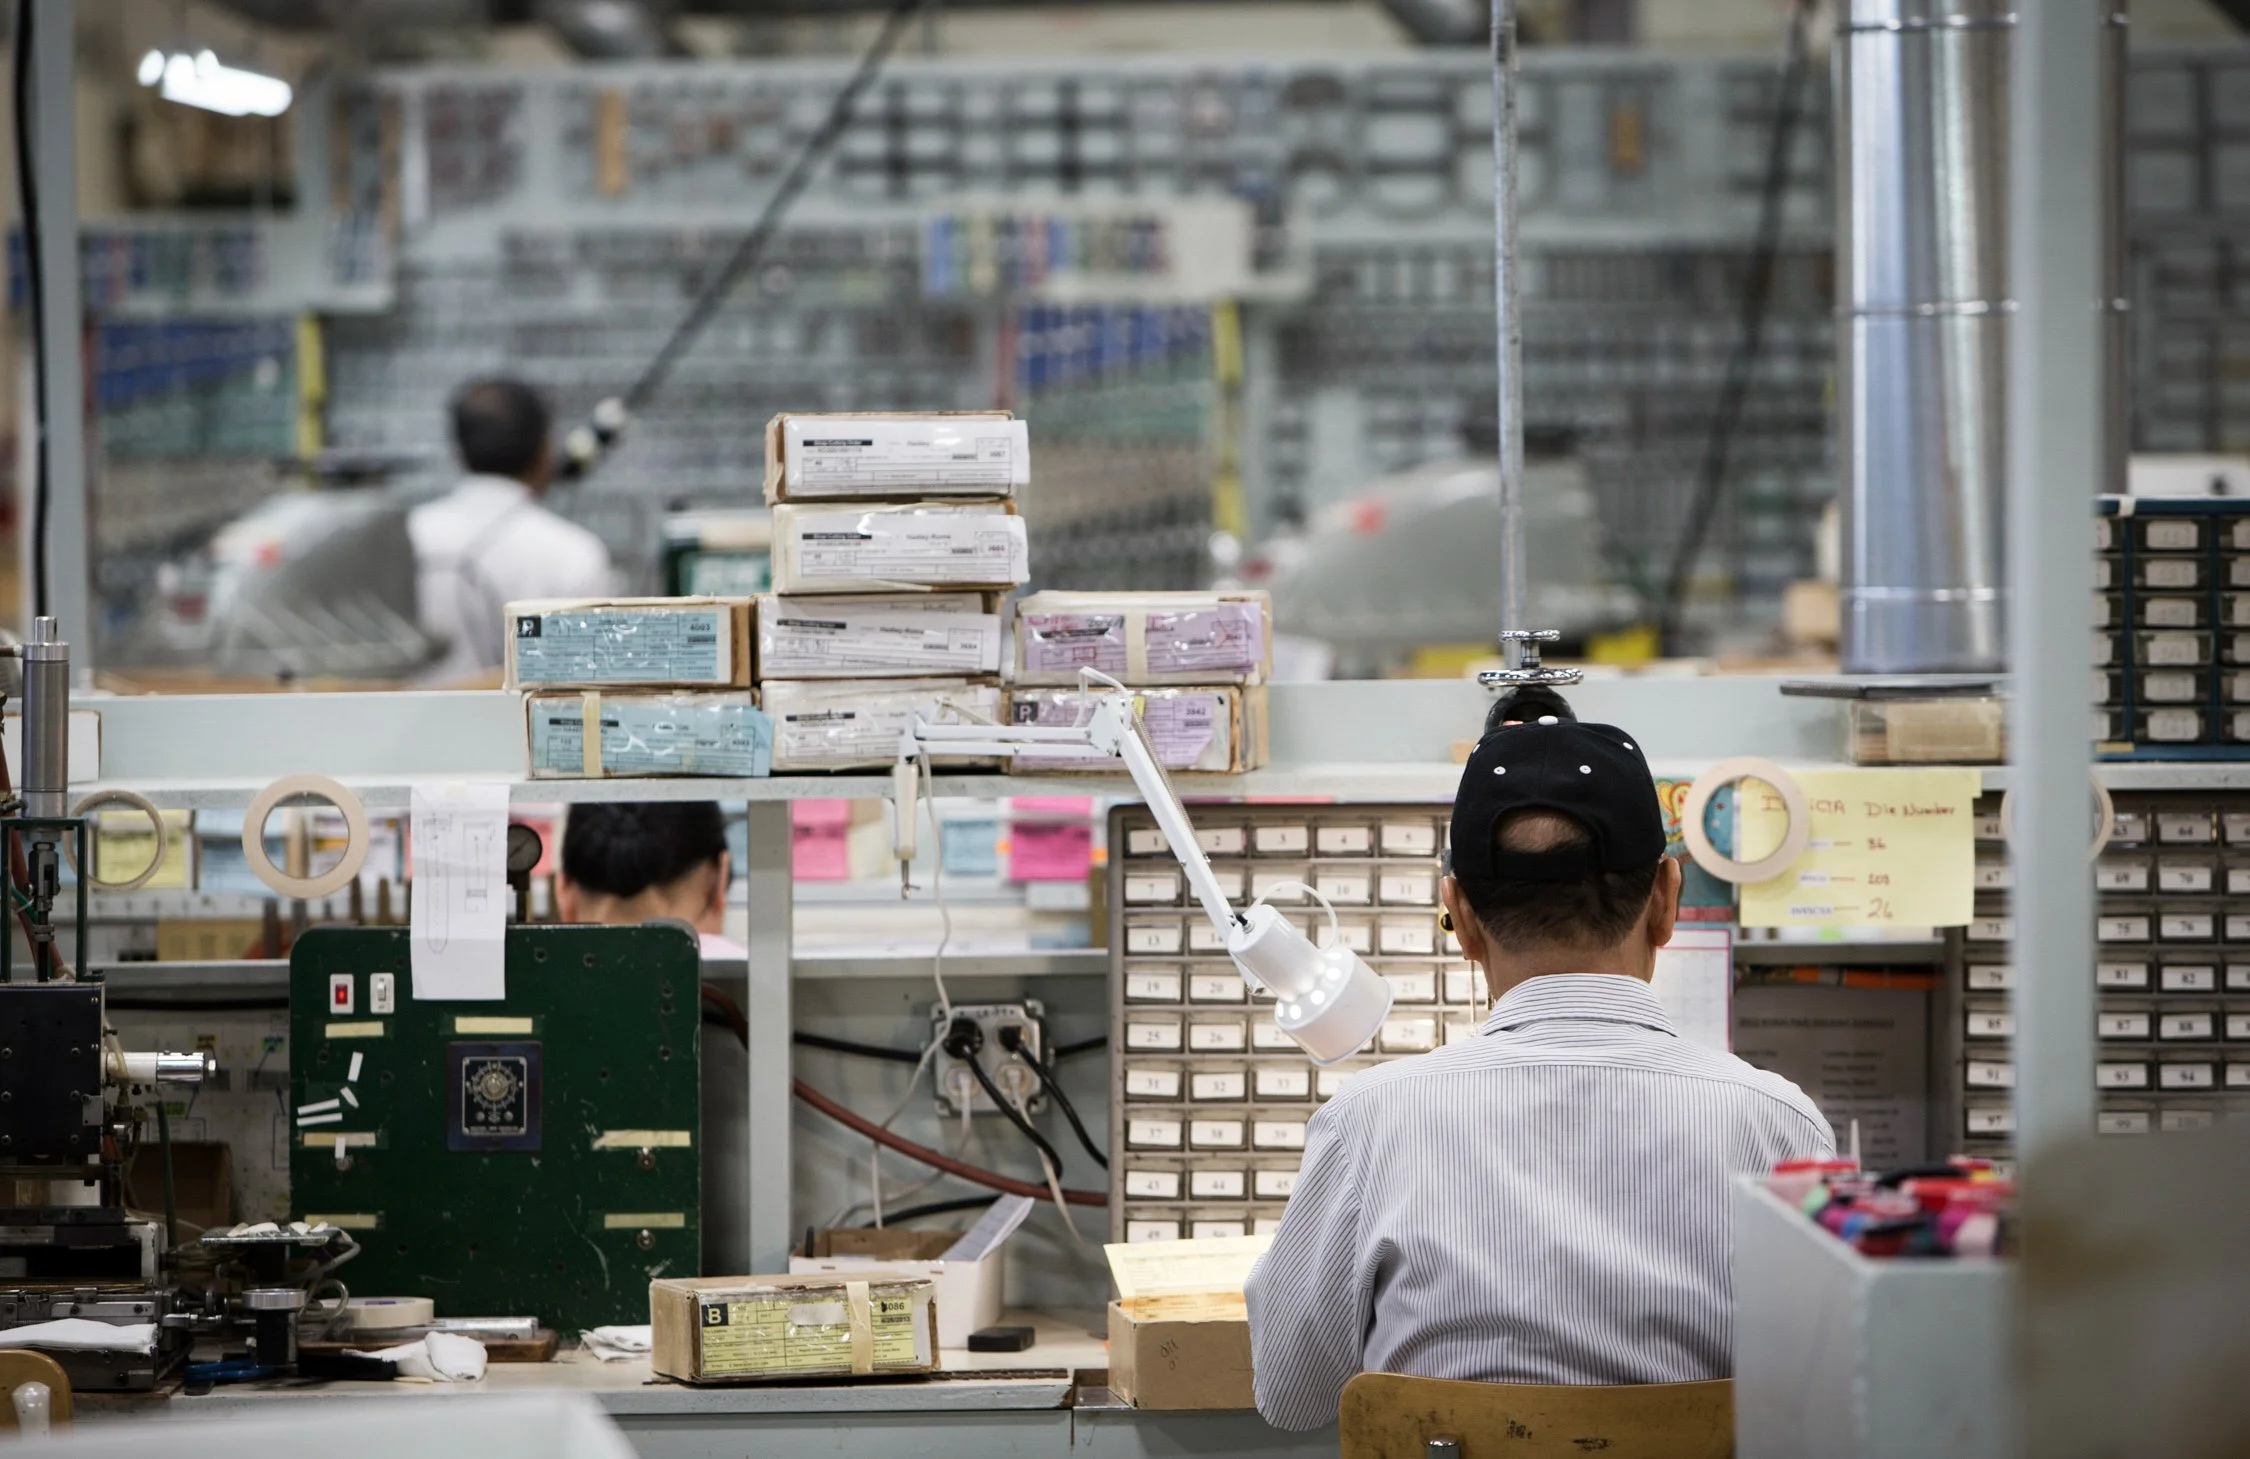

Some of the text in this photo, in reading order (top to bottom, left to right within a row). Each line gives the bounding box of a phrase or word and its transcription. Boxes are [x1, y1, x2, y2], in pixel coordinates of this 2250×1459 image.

[1019, 704, 1032, 720] P
[1865, 801, 1897, 818] Die
[1903, 801, 1956, 817] Number
[881, 1301, 905, 1312] 086
[707, 1308, 721, 1324] B
